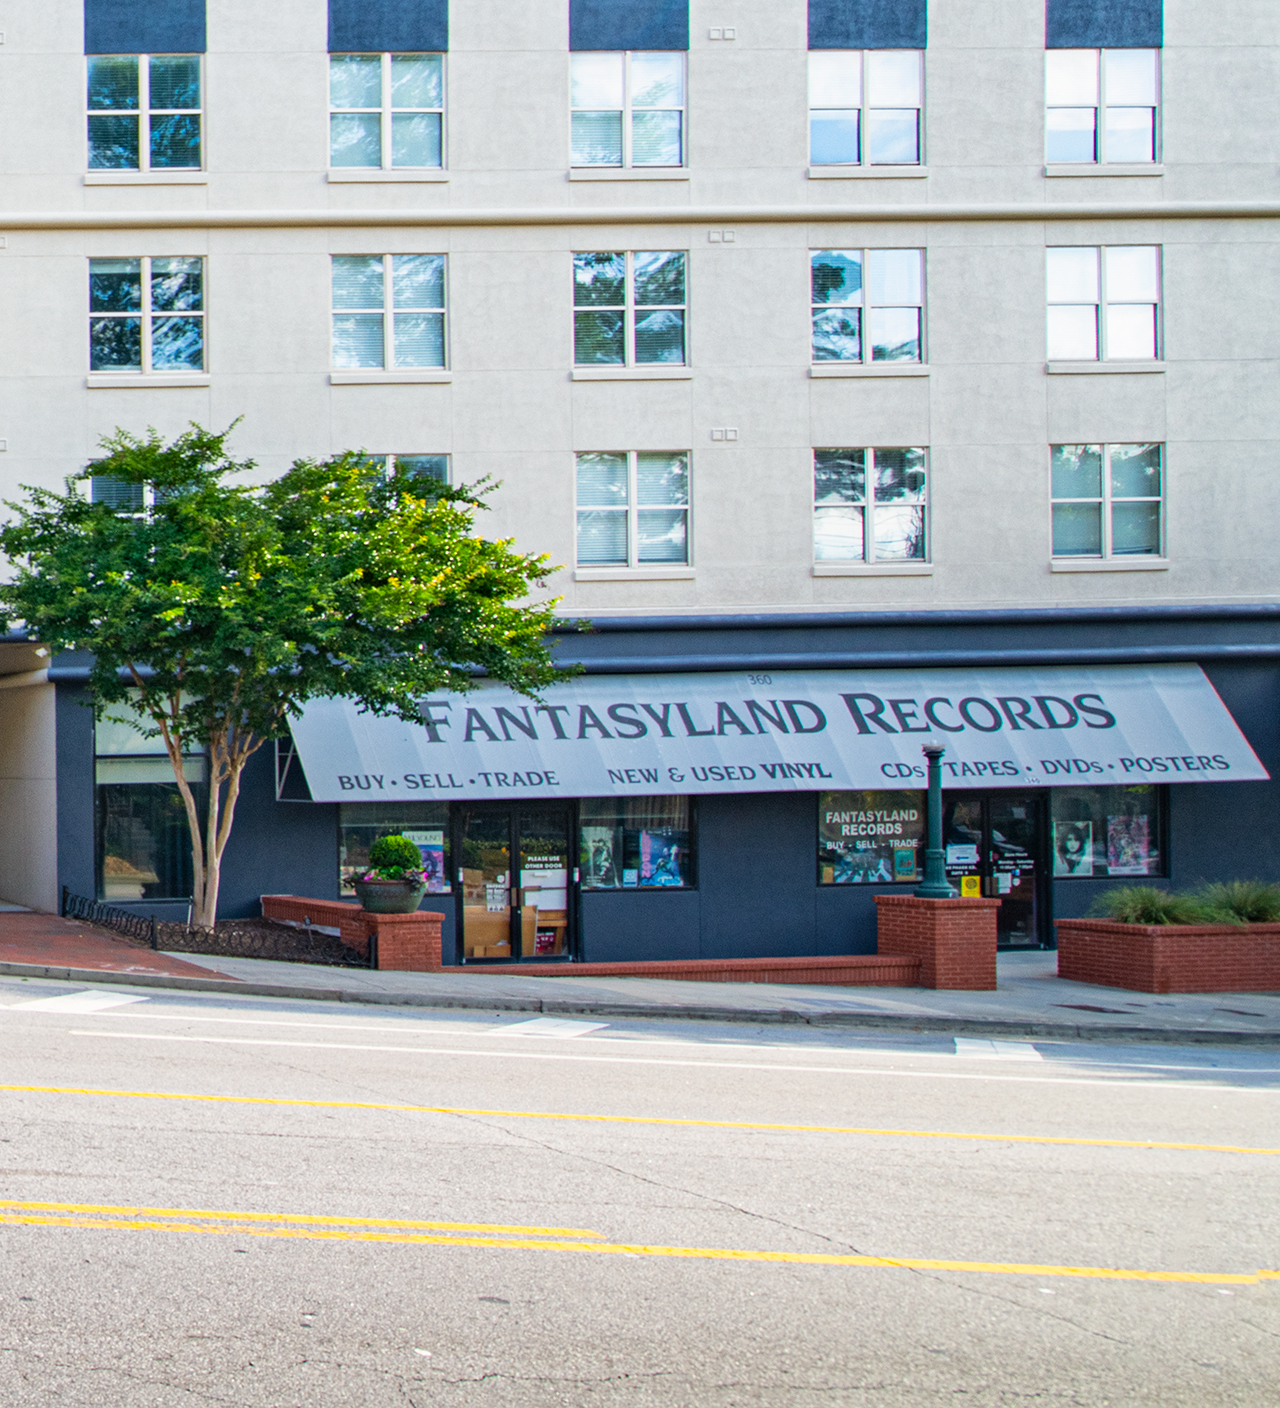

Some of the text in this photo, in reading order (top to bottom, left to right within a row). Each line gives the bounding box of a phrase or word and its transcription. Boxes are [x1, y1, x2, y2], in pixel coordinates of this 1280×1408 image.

[747, 674, 772, 685] 360
[418, 693, 1117, 743] FANTASYLAND RECORDS
[338, 774, 385, 790] BUY
[403, 773, 463, 789] SELL
[478, 771, 560, 787] TRADE
[607, 768, 659, 784] NEW
[668, 767, 686, 783] &
[690, 766, 757, 782] USED
[759, 763, 833, 779] VINYL
[943, 760, 1020, 777] TAPES
[1119, 755, 1231, 773] POSTERS
[825, 809, 919, 823] FANTASYLAND
[841, 822, 903, 836] RECORDS
[826, 838, 919, 850] BUY SELL TRADE
